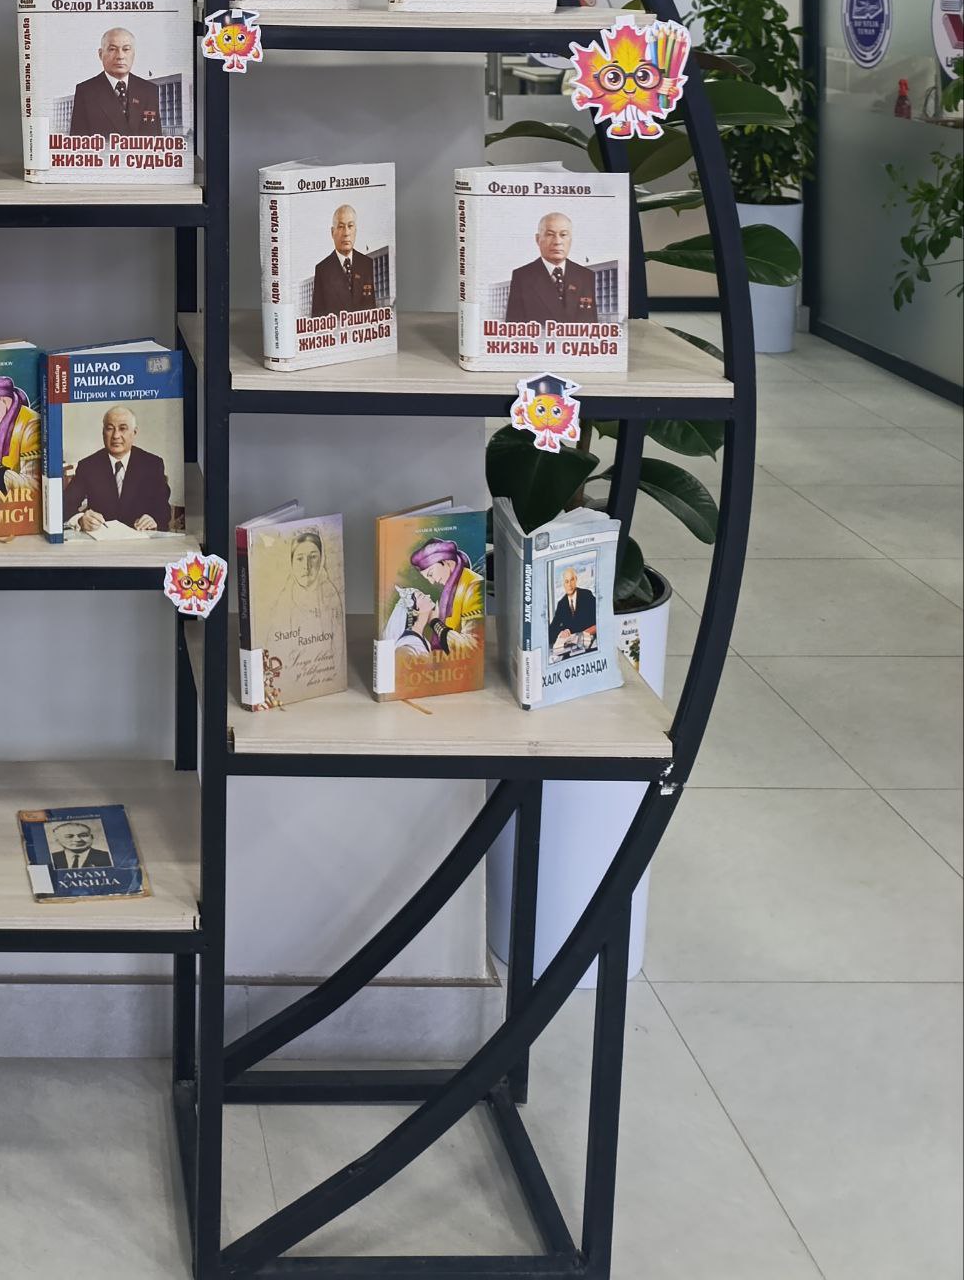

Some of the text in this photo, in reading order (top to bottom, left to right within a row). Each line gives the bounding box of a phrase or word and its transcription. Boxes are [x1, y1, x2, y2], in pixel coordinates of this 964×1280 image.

[52, 0, 154, 11] Федор Раззаков
[50, 134, 104, 152] Шараф
[52, 153, 182, 169] жизнь и судьба
[298, 176, 369, 191] Федор Раззаков
[488, 182, 591, 195] Федор Раззаков
[270, 200, 280, 232] судьба
[270, 247, 279, 276] жизнь
[297, 313, 336, 334] Шараф
[484, 321, 540, 337] Шараф
[299, 324, 390, 351] жизнь и судьба
[487, 340, 617, 355] жизнь и судьба
[74, 363, 121, 373] ШАРАФ
[74, 376, 134, 386] РАШИДОВ
[74, 390, 107, 400] Штрихи
[120, 389, 159, 398] портрету
[275, 626, 333, 646] Sharof Rashidov
[542, 673, 562, 688] ХАЛҚ
[565, 659, 607, 680] ФАРЗАНДИ
